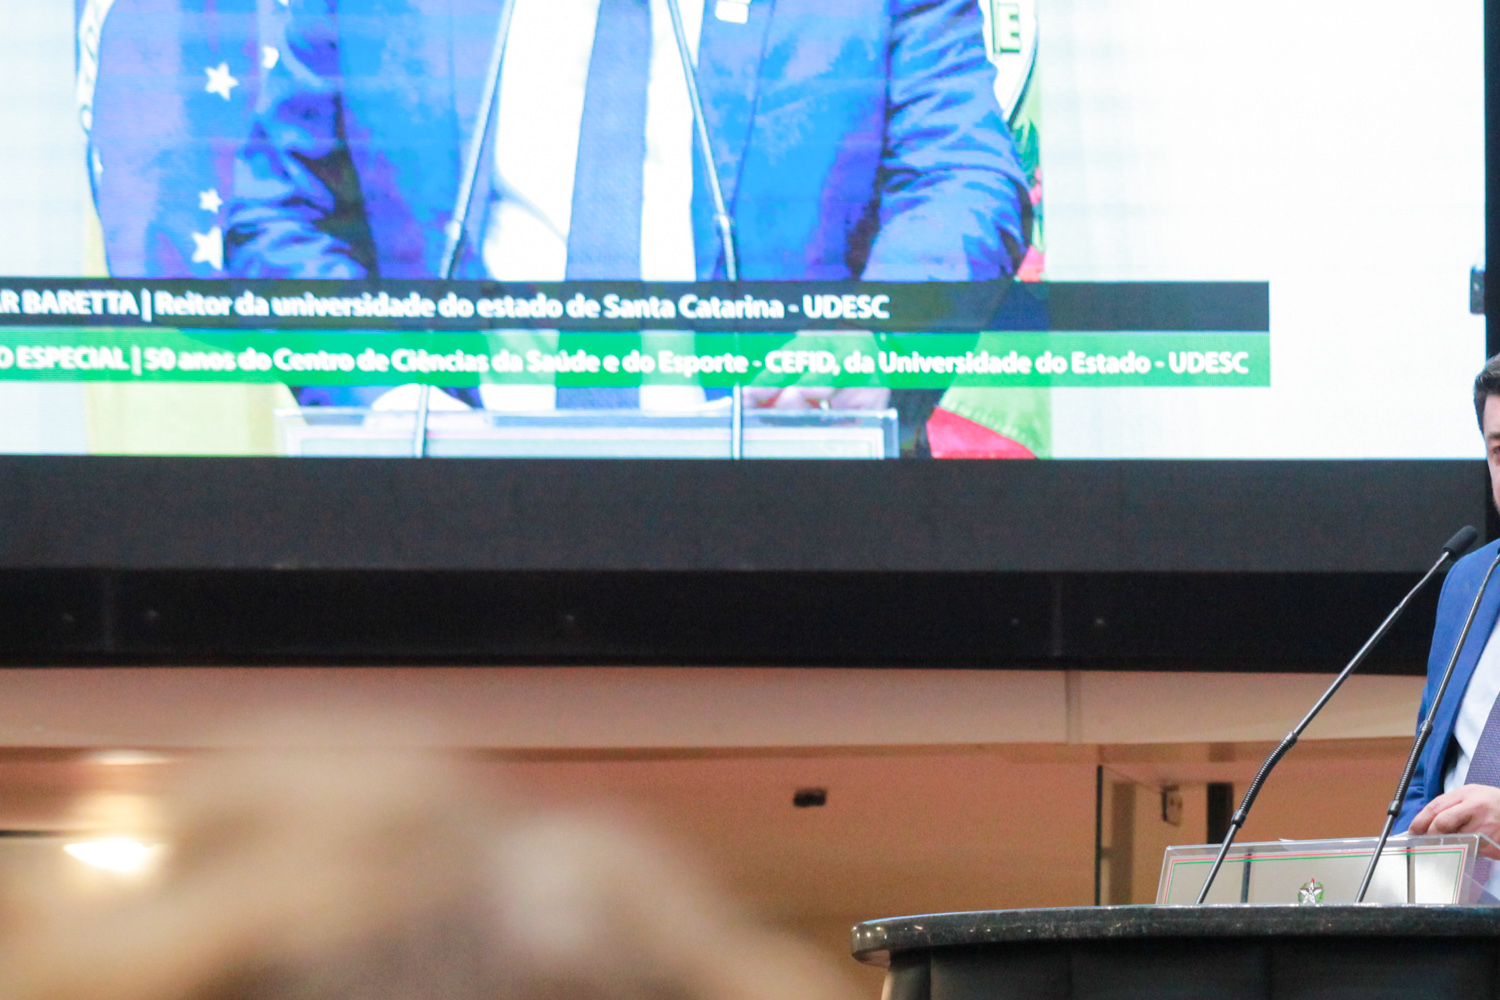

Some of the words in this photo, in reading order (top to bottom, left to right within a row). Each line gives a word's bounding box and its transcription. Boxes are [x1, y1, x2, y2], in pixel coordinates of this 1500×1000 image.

[0, 289, 20, 314] R
[21, 289, 140, 315] BARETTA
[154, 290, 233, 316] Reitor
[234, 290, 270, 316] da
[271, 291, 437, 318] universidade
[438, 292, 475, 318] do
[476, 292, 564, 318] estado
[566, 292, 601, 318] de
[603, 293, 676, 319] Santa
[678, 293, 785, 319] Catarina
[803, 294, 890, 319] UDESC
[16, 346, 130, 370] ESPECIAL
[144, 347, 177, 371] 50
[178, 352, 237, 371] anos
[237, 347, 273, 371] do
[273, 347, 355, 371] Centro
[356, 348, 390, 372] de
[391, 348, 490, 373] Ciências
[491, 349, 524, 373] da
[525, 349, 601, 373] Saúde
[603, 355, 620, 373] e
[622, 349, 656, 373] do
[658, 349, 749, 378] Esporte
[765, 350, 841, 376] CEFID,
[843, 349, 875, 373] da
[878, 350, 1032, 374] Universidade
[1035, 350, 1068, 374] do
[1071, 350, 1152, 374] Estado
[1168, 351, 1249, 374] UDESC
